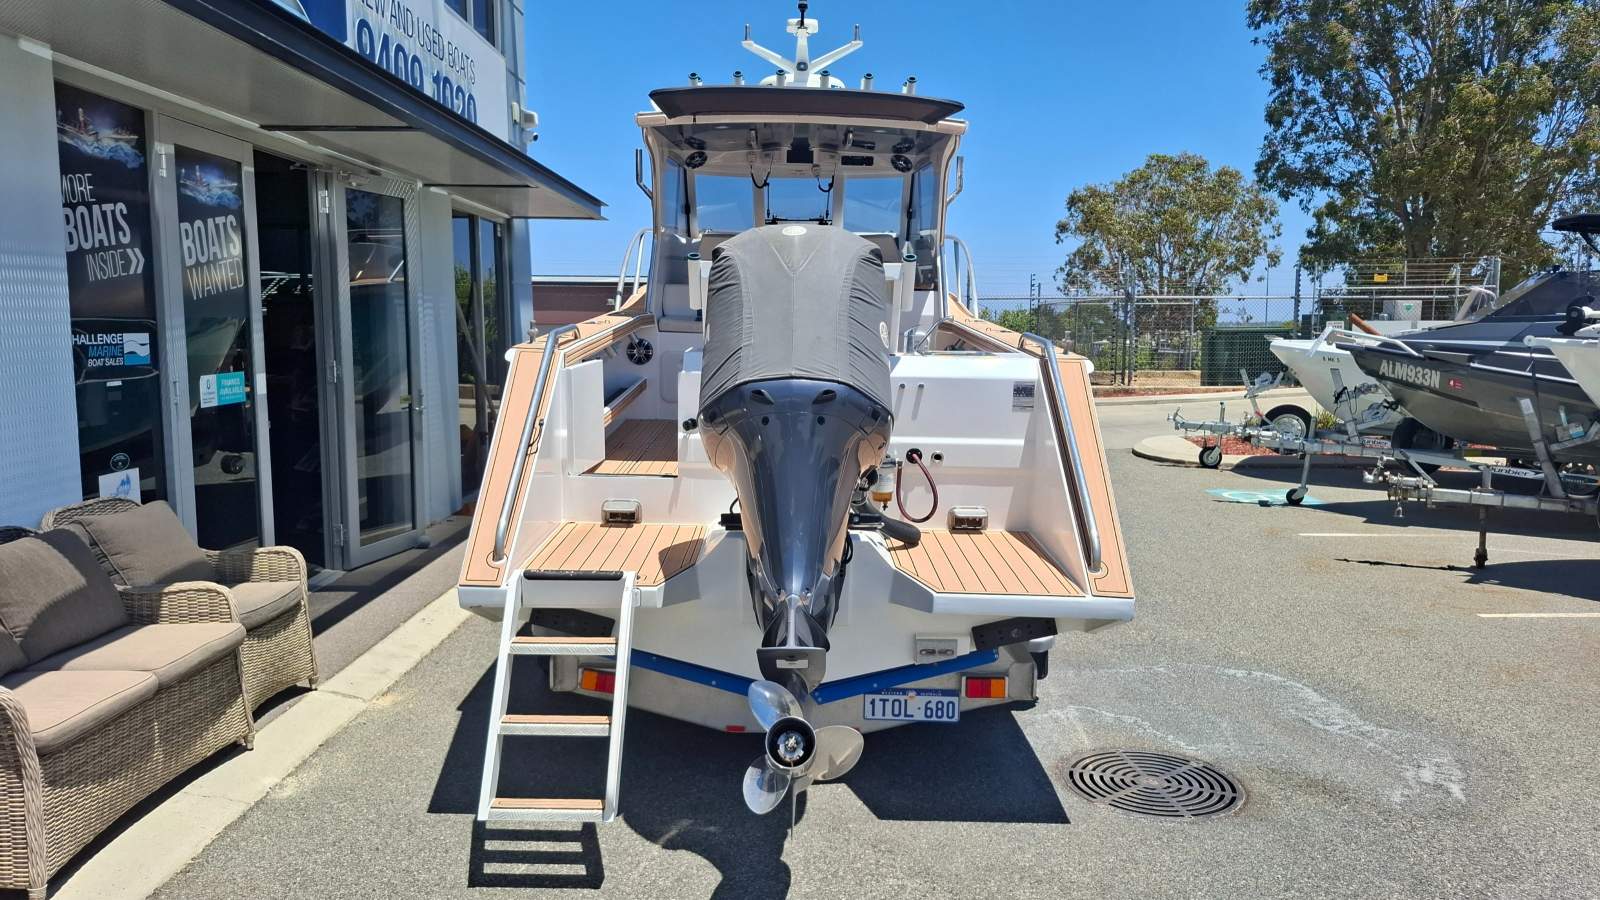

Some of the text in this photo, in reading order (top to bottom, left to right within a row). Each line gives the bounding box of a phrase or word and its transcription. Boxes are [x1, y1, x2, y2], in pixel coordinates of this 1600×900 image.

[389, 0, 414, 38] AND
[417, 17, 445, 61] USED
[448, 41, 476, 85] BOATS
[63, 202, 131, 252] BOATS
[180, 214, 240, 267] BOATS
[86, 249, 128, 281] INSIDE
[187, 258, 244, 301] WANTED
[72, 333, 124, 345] HALLENGE
[88, 345, 123, 357] MARINE
[88, 357, 124, 367] BOAT SALES
[1379, 359, 1441, 389] ALM933N
